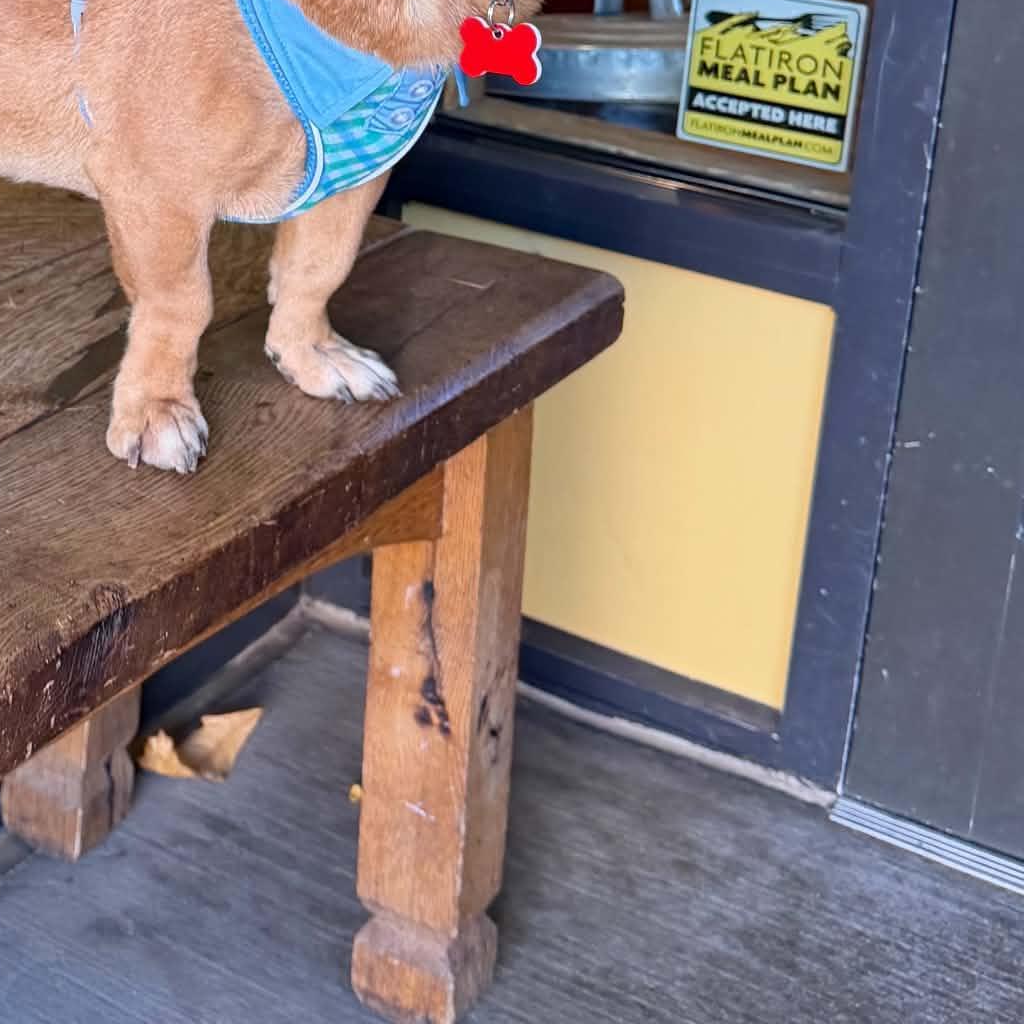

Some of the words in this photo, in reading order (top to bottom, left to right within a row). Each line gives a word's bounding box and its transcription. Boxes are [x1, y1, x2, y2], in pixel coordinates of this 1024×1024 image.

[700, 36, 843, 80] FLATIRON
[697, 61, 766, 86] MEAL
[772, 74, 841, 101] PLAN
[692, 92, 785, 123] ACCEPTED
[788, 109, 838, 134] HERE
[689, 118, 833, 155] FLATIRONMEALPLAN.COM
